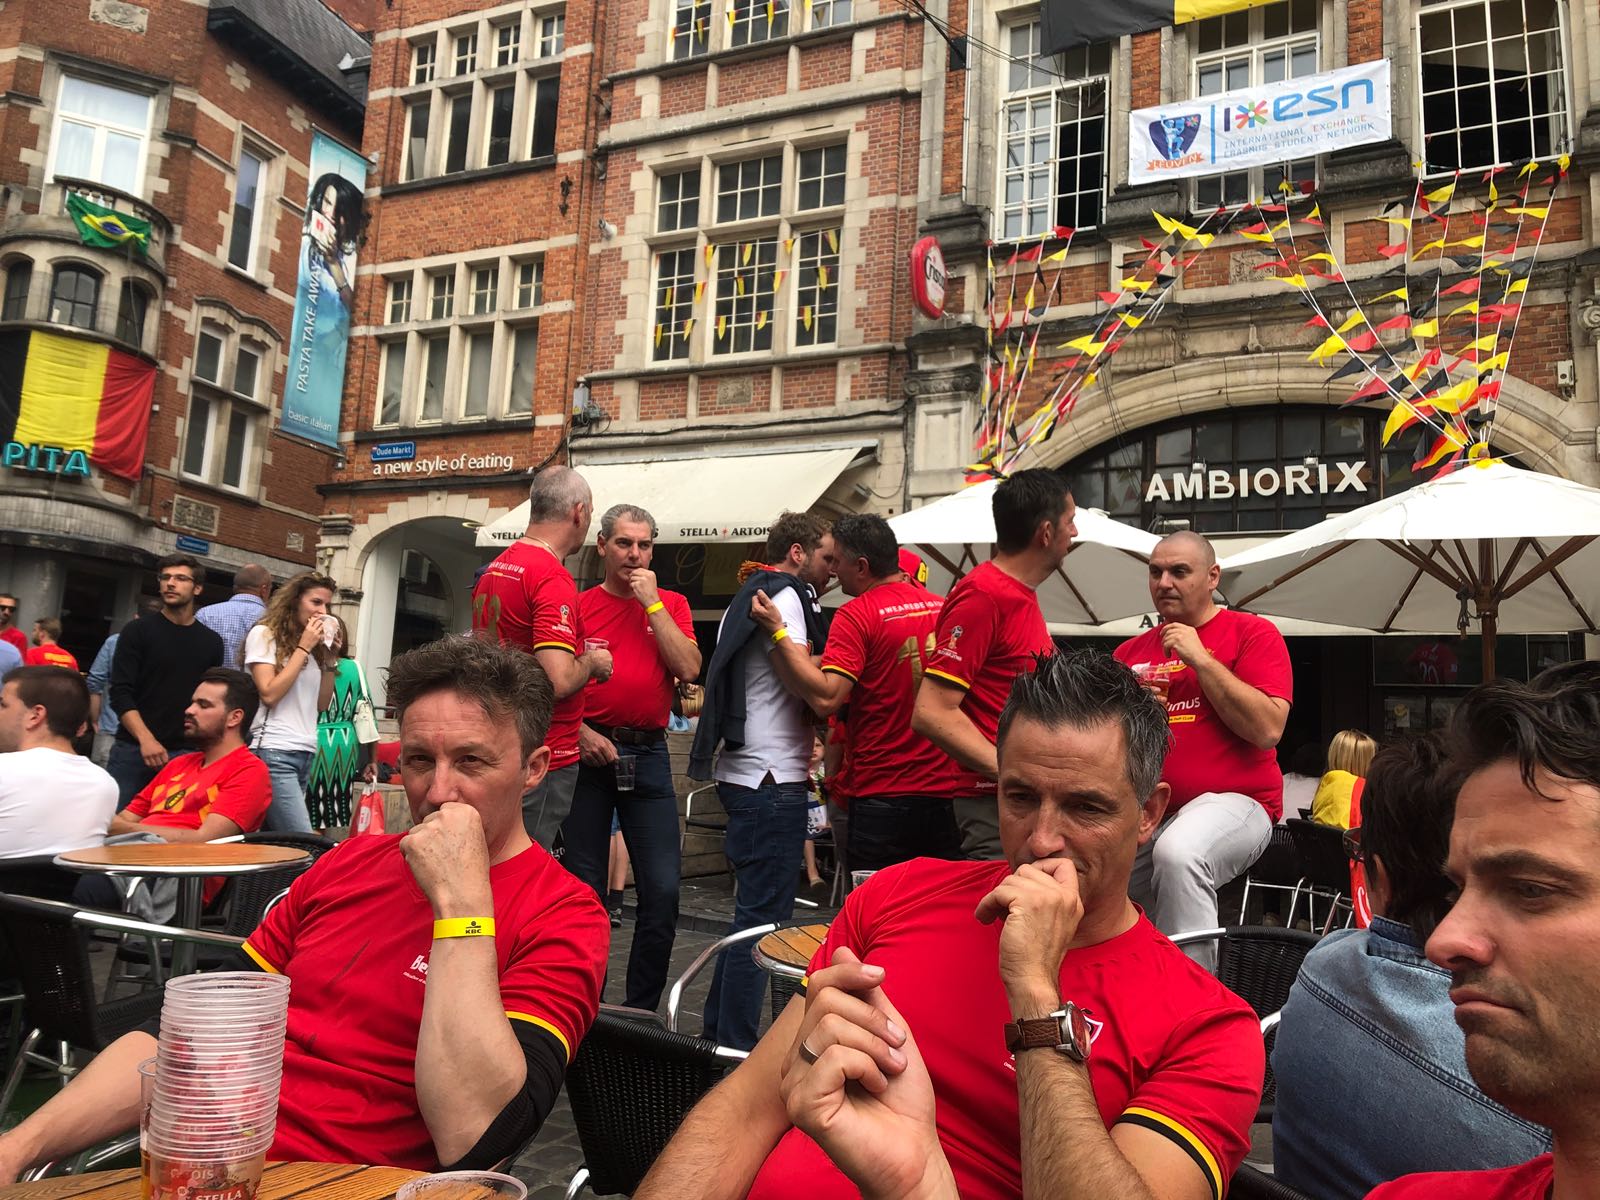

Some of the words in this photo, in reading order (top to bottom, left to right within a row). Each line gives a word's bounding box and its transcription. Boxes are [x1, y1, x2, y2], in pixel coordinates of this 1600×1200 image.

[1273, 78, 1374, 122] esn
[1224, 128, 1306, 149] INTERNATIONAL
[1312, 114, 1368, 132] EXCHANGE
[1274, 134, 1319, 149] STUDENT
[1327, 122, 1376, 139] NETWORK
[1153, 153, 1197, 168] LEUVEN
[307, 259, 322, 305] AWAY
[302, 305, 318, 343] TAKE
[296, 345, 312, 393] PASTA
[288, 405, 309, 424] basic
[310, 416, 332, 432] italian
[2, 441, 92, 478] PITA
[373, 463, 381, 475] a
[384, 461, 412, 474] new
[415, 455, 448, 476] style
[450, 453, 467, 470] of
[468, 452, 513, 471] eating
[376, 448, 391, 456] Oude
[392, 446, 411, 454] Markt
[1145, 460, 1368, 502] AMBIORIX
[491, 531, 525, 540] STELLA
[679, 527, 718, 537] STELLA
[731, 526, 771, 536] ARTOIS
[1167, 697, 1201, 712] imus
[195, 1189, 242, 1200] STELLA
